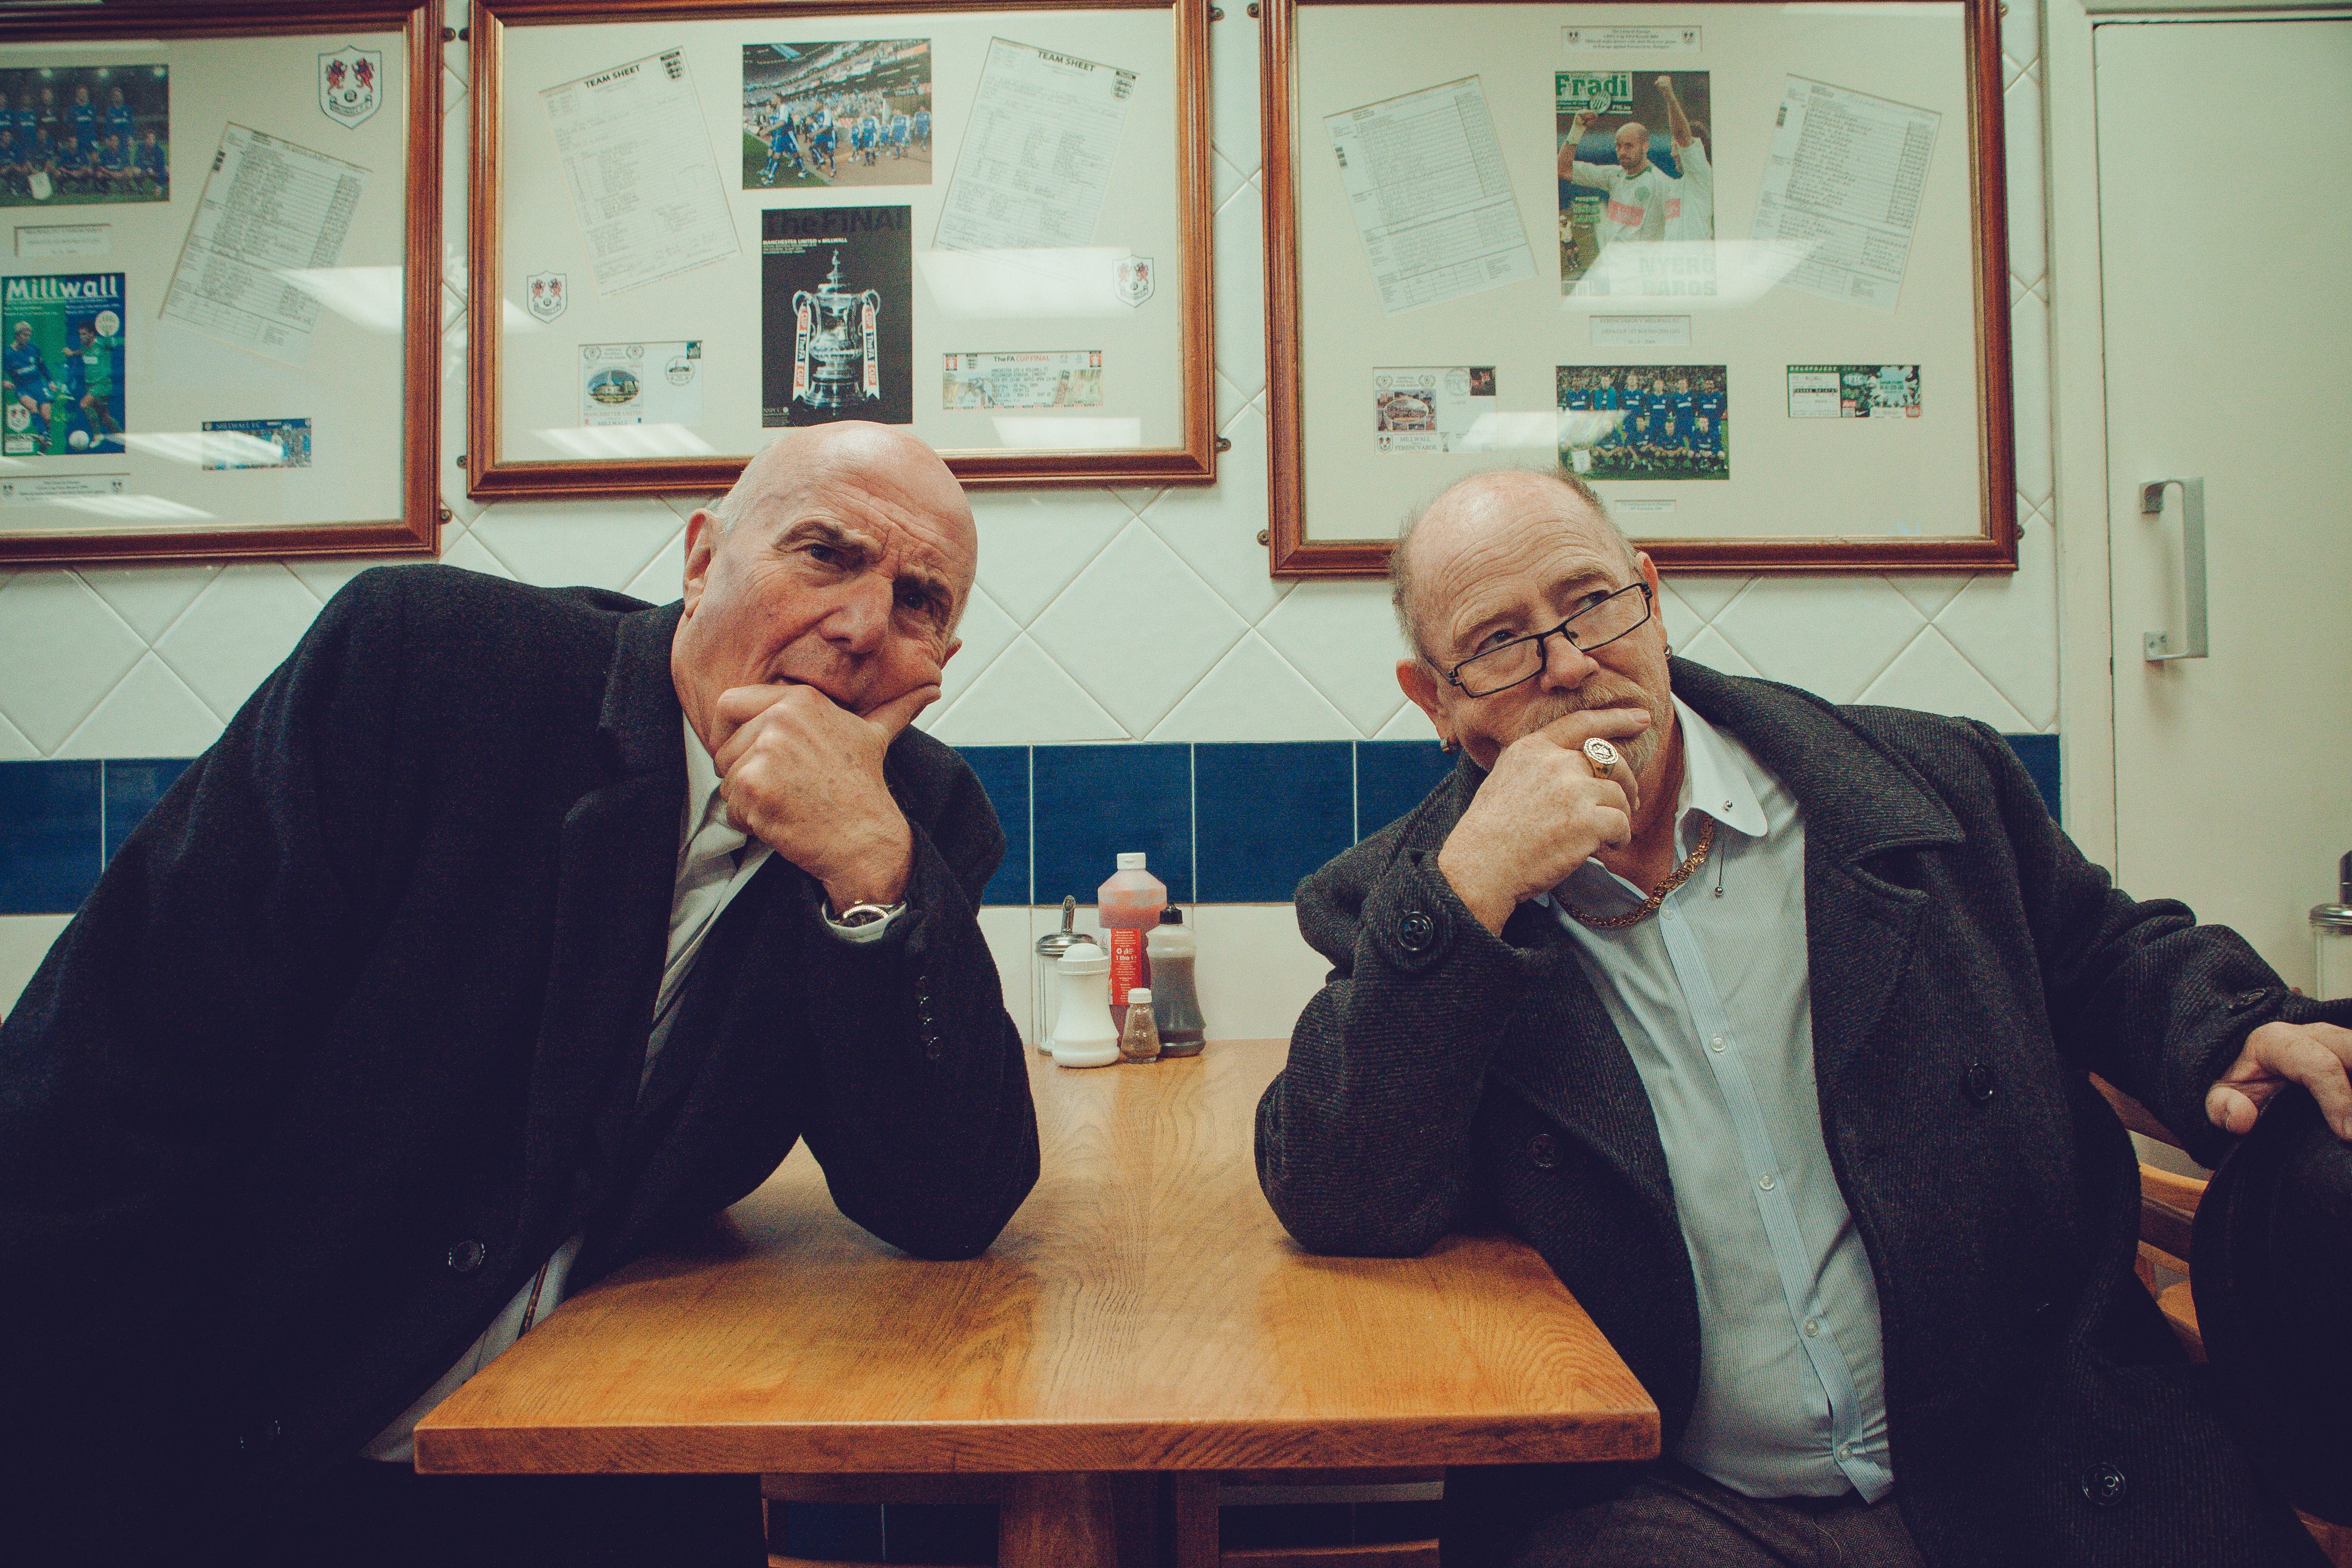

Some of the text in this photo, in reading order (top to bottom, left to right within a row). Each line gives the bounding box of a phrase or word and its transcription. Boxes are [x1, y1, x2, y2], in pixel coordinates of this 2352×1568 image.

[1038, 51, 1063, 64] TEAM
[1065, 57, 1096, 72] SHEET
[585, 75, 610, 89] TEAM
[613, 64, 640, 79] SHEET
[1555, 74, 1628, 96] Fradi
[6, 276, 118, 300] Millwall
